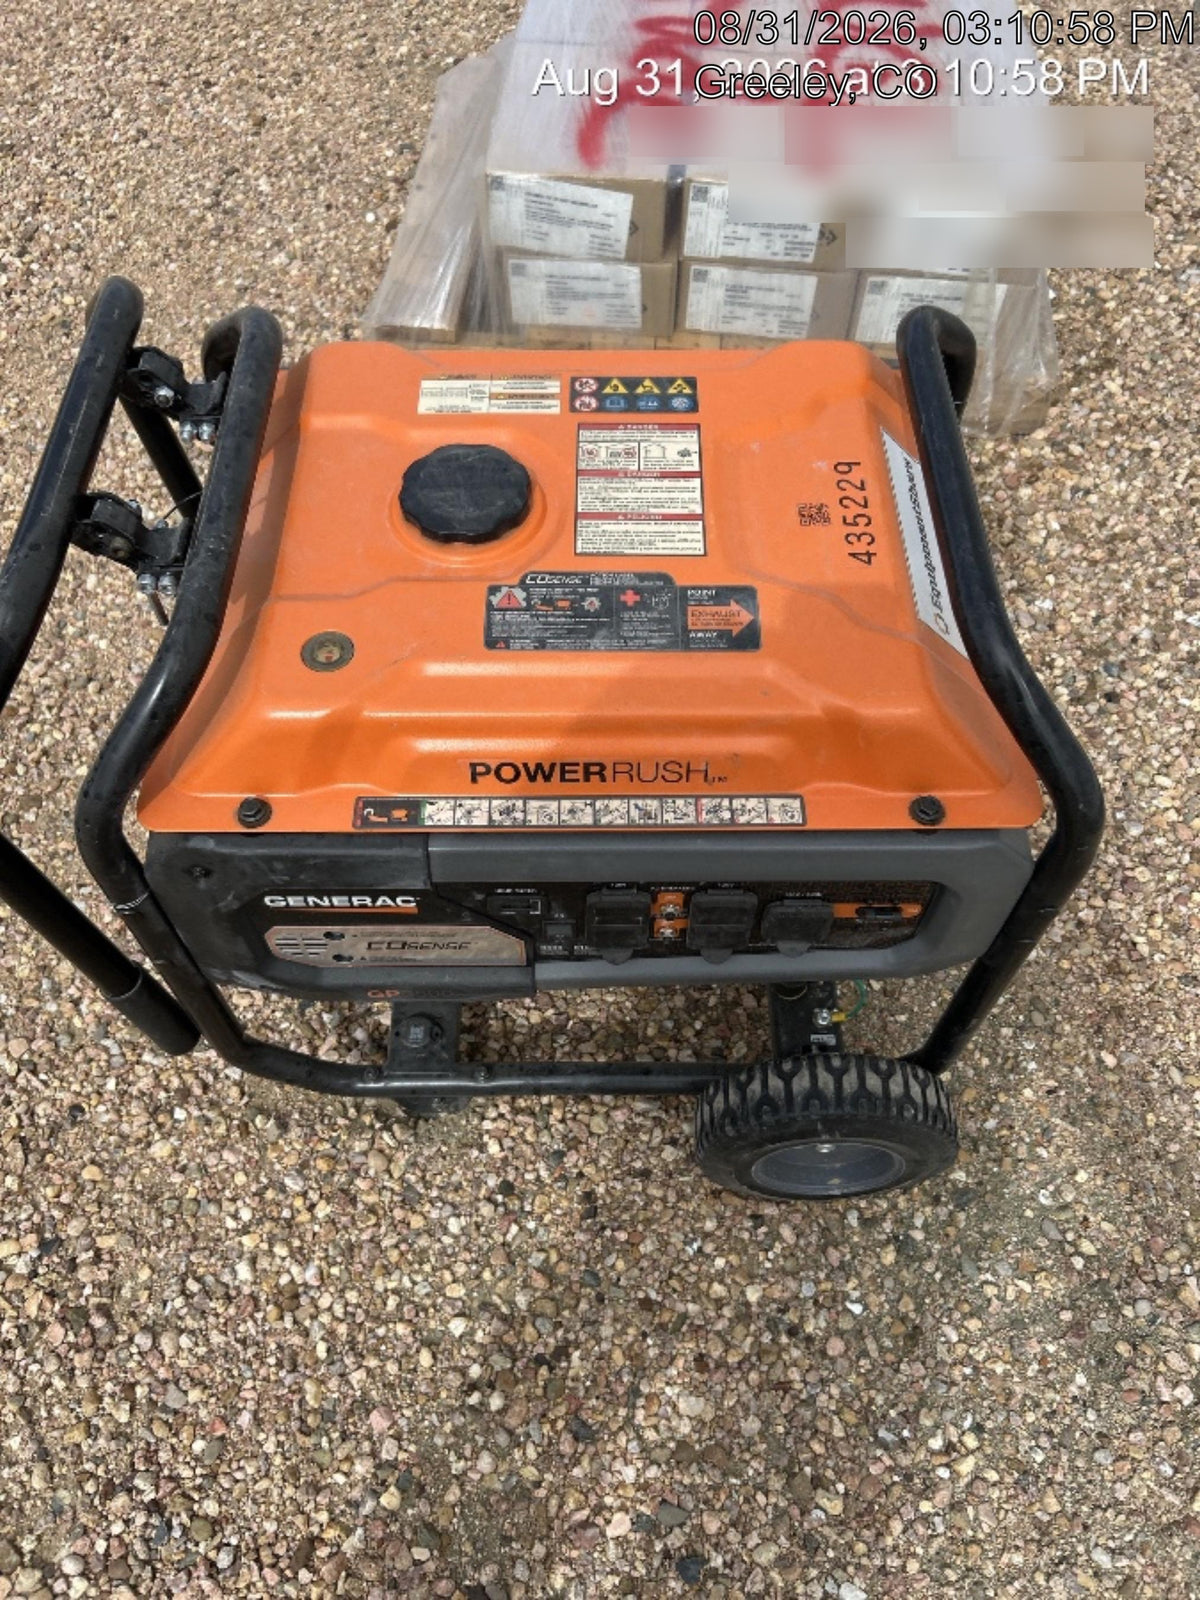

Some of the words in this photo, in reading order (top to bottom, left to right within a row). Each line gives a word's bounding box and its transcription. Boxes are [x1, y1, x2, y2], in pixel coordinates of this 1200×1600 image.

[833, 460, 878, 567] 435229
[690, 609, 741, 618] EXHAUST
[264, 894, 417, 909] GENERAC
